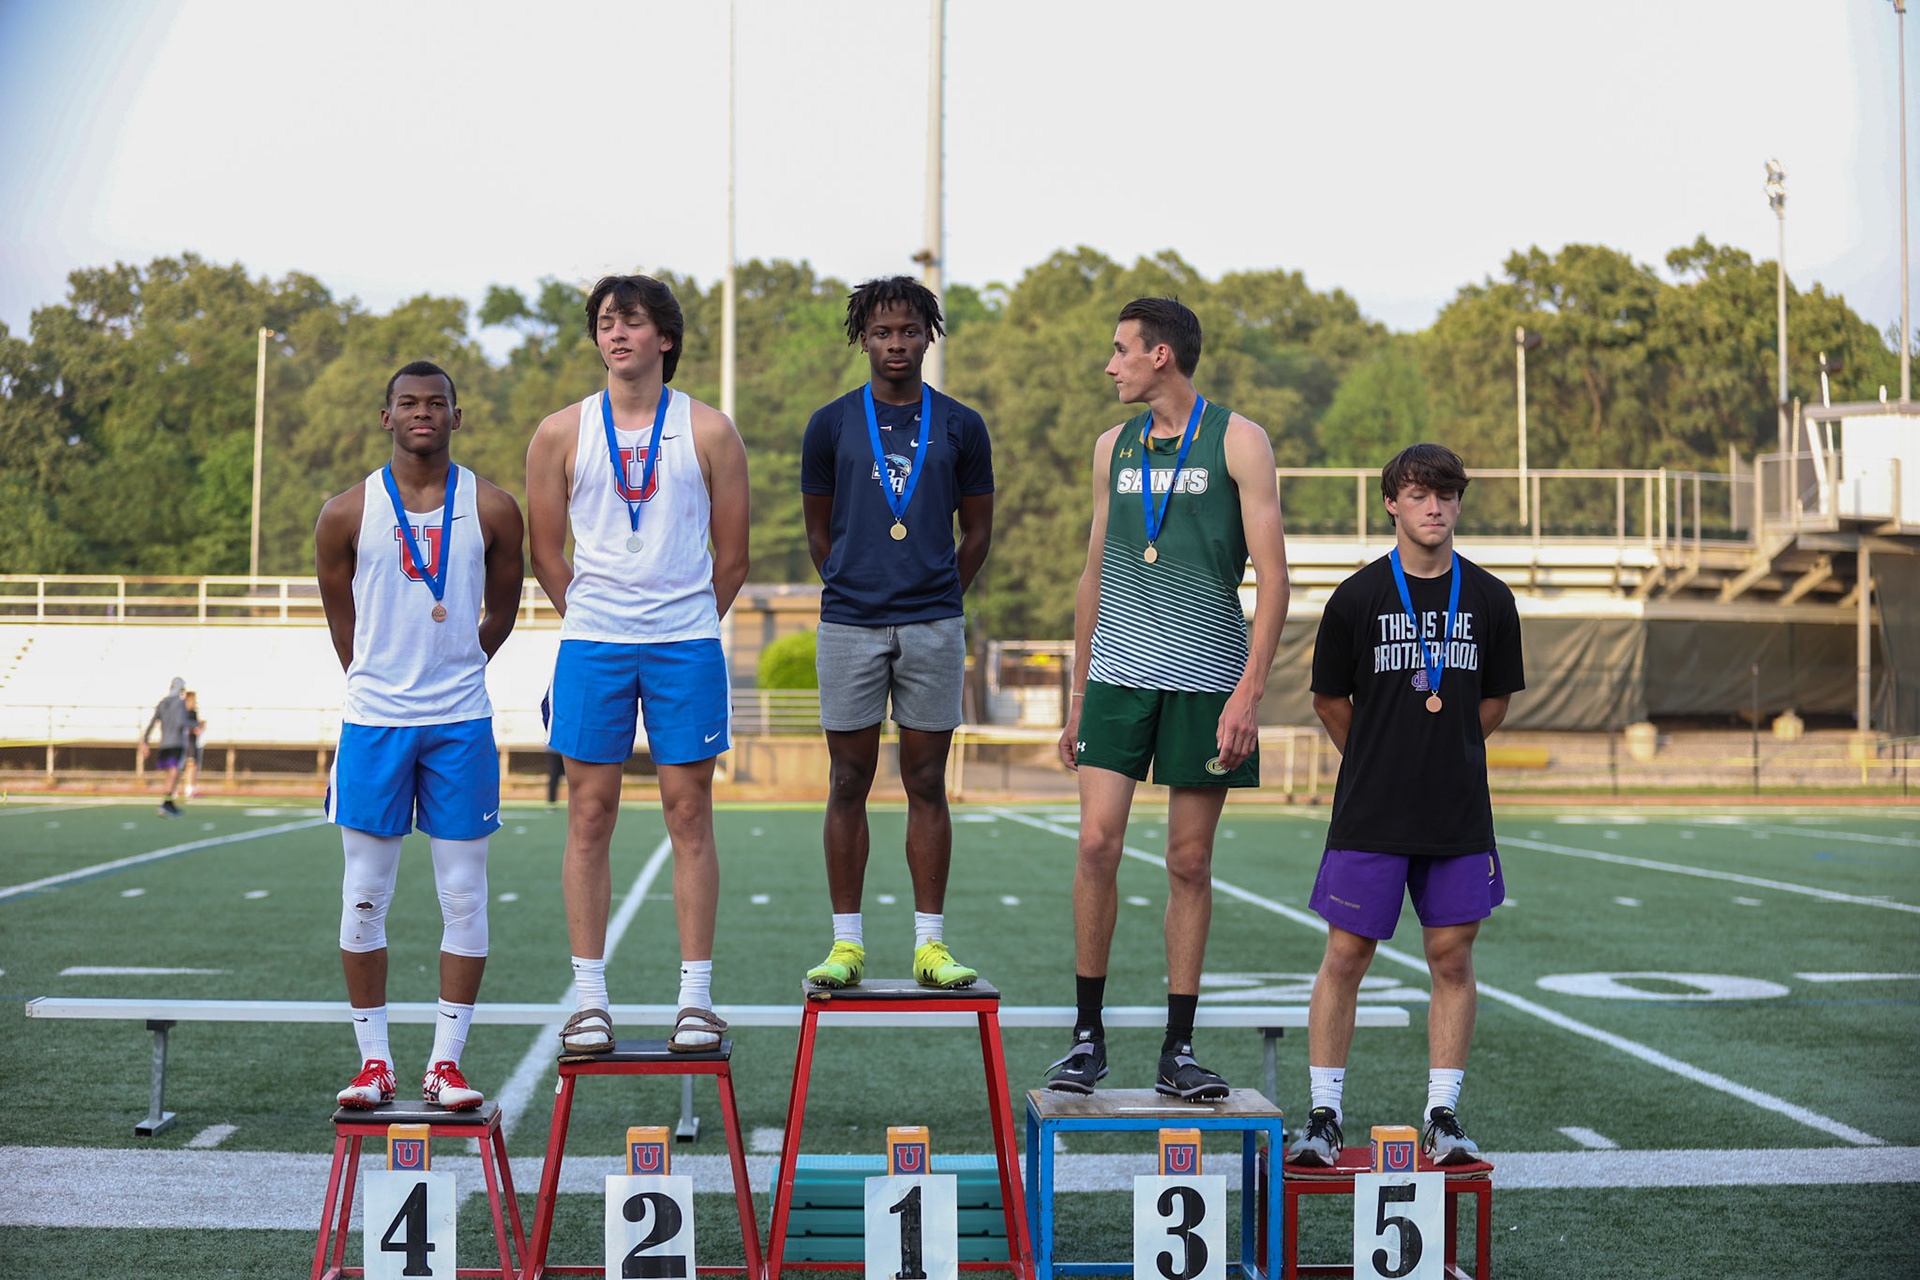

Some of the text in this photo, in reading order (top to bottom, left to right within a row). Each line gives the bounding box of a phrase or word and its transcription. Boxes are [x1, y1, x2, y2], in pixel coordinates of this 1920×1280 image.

[609, 446, 661, 503] U
[1117, 468, 1208, 494] SAINTS
[394, 525, 447, 582] U
[1377, 611, 1473, 642] THIS IS THE
[395, 1142, 421, 1167] U
[635, 1146, 660, 1170] U
[896, 1146, 922, 1172] U
[1168, 1146, 1193, 1171] U
[1387, 1144, 1410, 1169] U
[380, 1182, 435, 1277] 4
[622, 1192, 687, 1279] 2
[889, 1186, 927, 1280] 1
[1156, 1186, 1208, 1280] 3
[1372, 1183, 1423, 1279] 5
